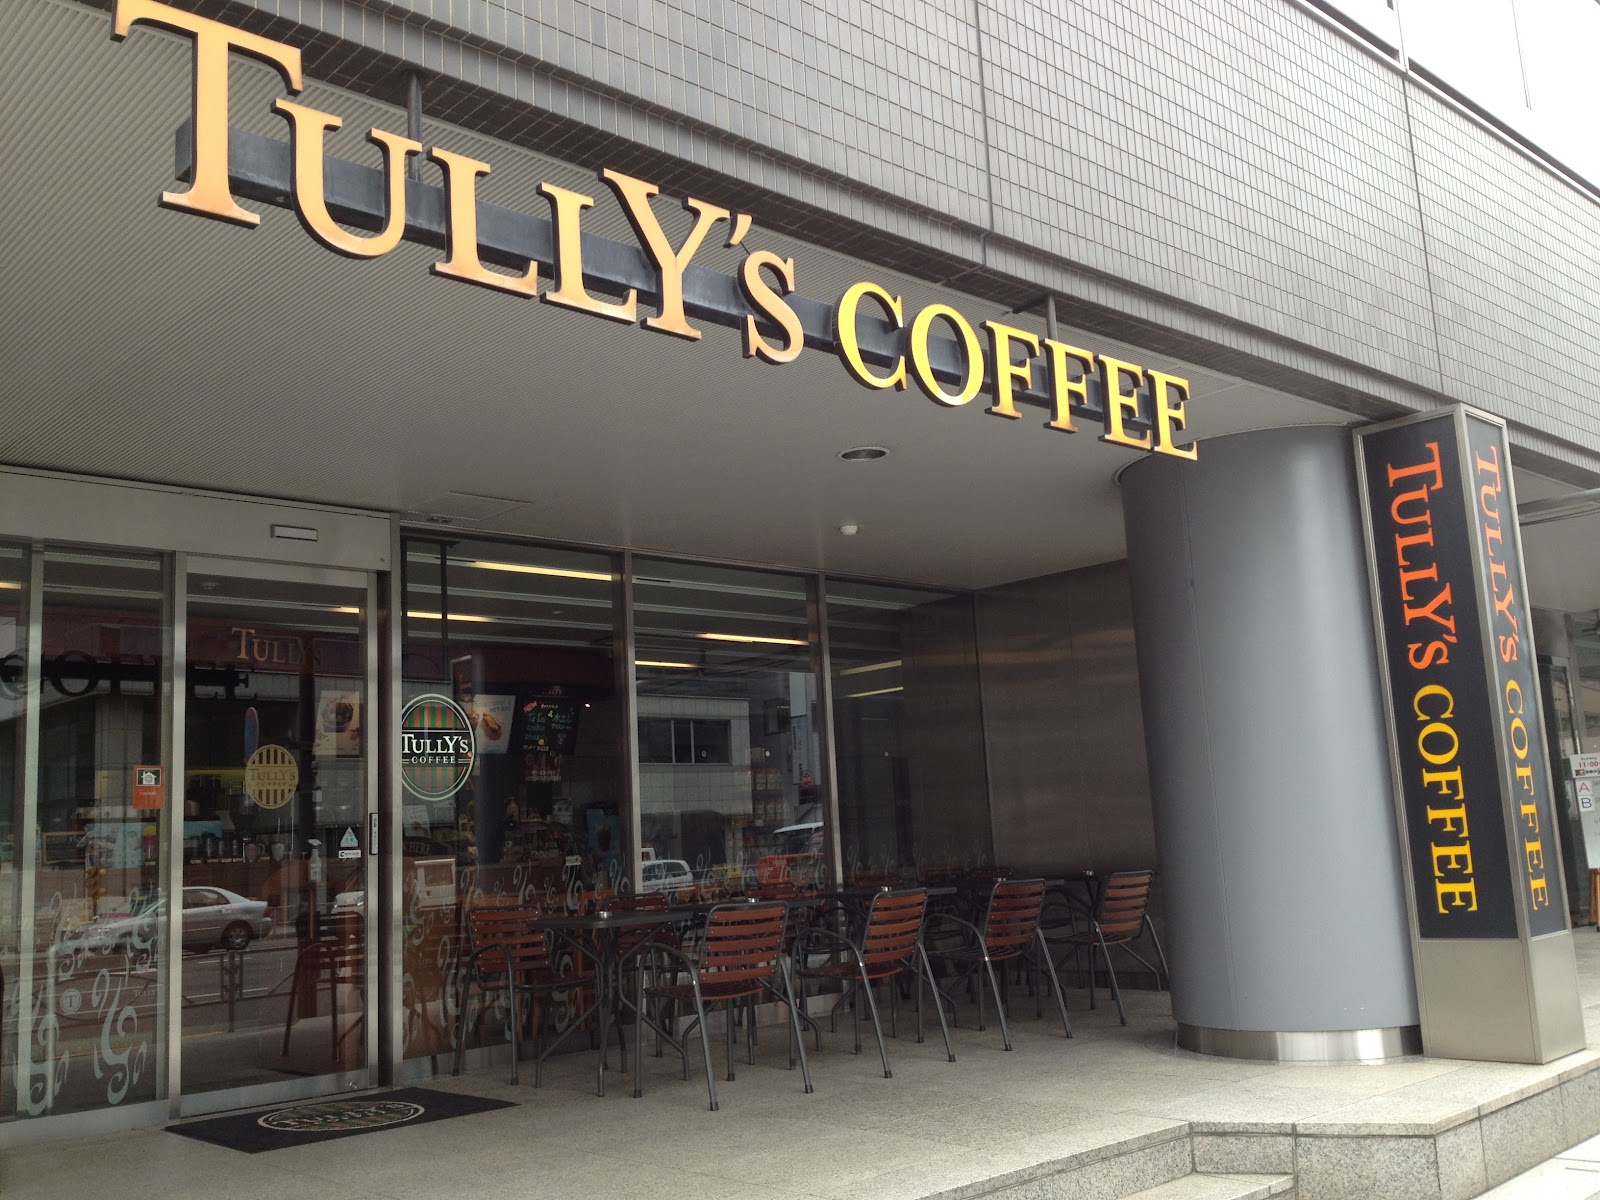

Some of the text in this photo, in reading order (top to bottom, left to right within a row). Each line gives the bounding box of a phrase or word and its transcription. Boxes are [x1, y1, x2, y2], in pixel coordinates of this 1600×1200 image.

[110, 0, 1198, 461] TULLY'S COFFEE
[1387, 441, 1477, 914] TULLY'S COFFEE
[1476, 445, 1549, 911] TULLY'S COFFEE
[402, 734, 469, 754] TULLY'S
[411, 756, 456, 764] COFFEE
[1579, 782, 1590, 793] A
[1581, 797, 1592, 809] B
